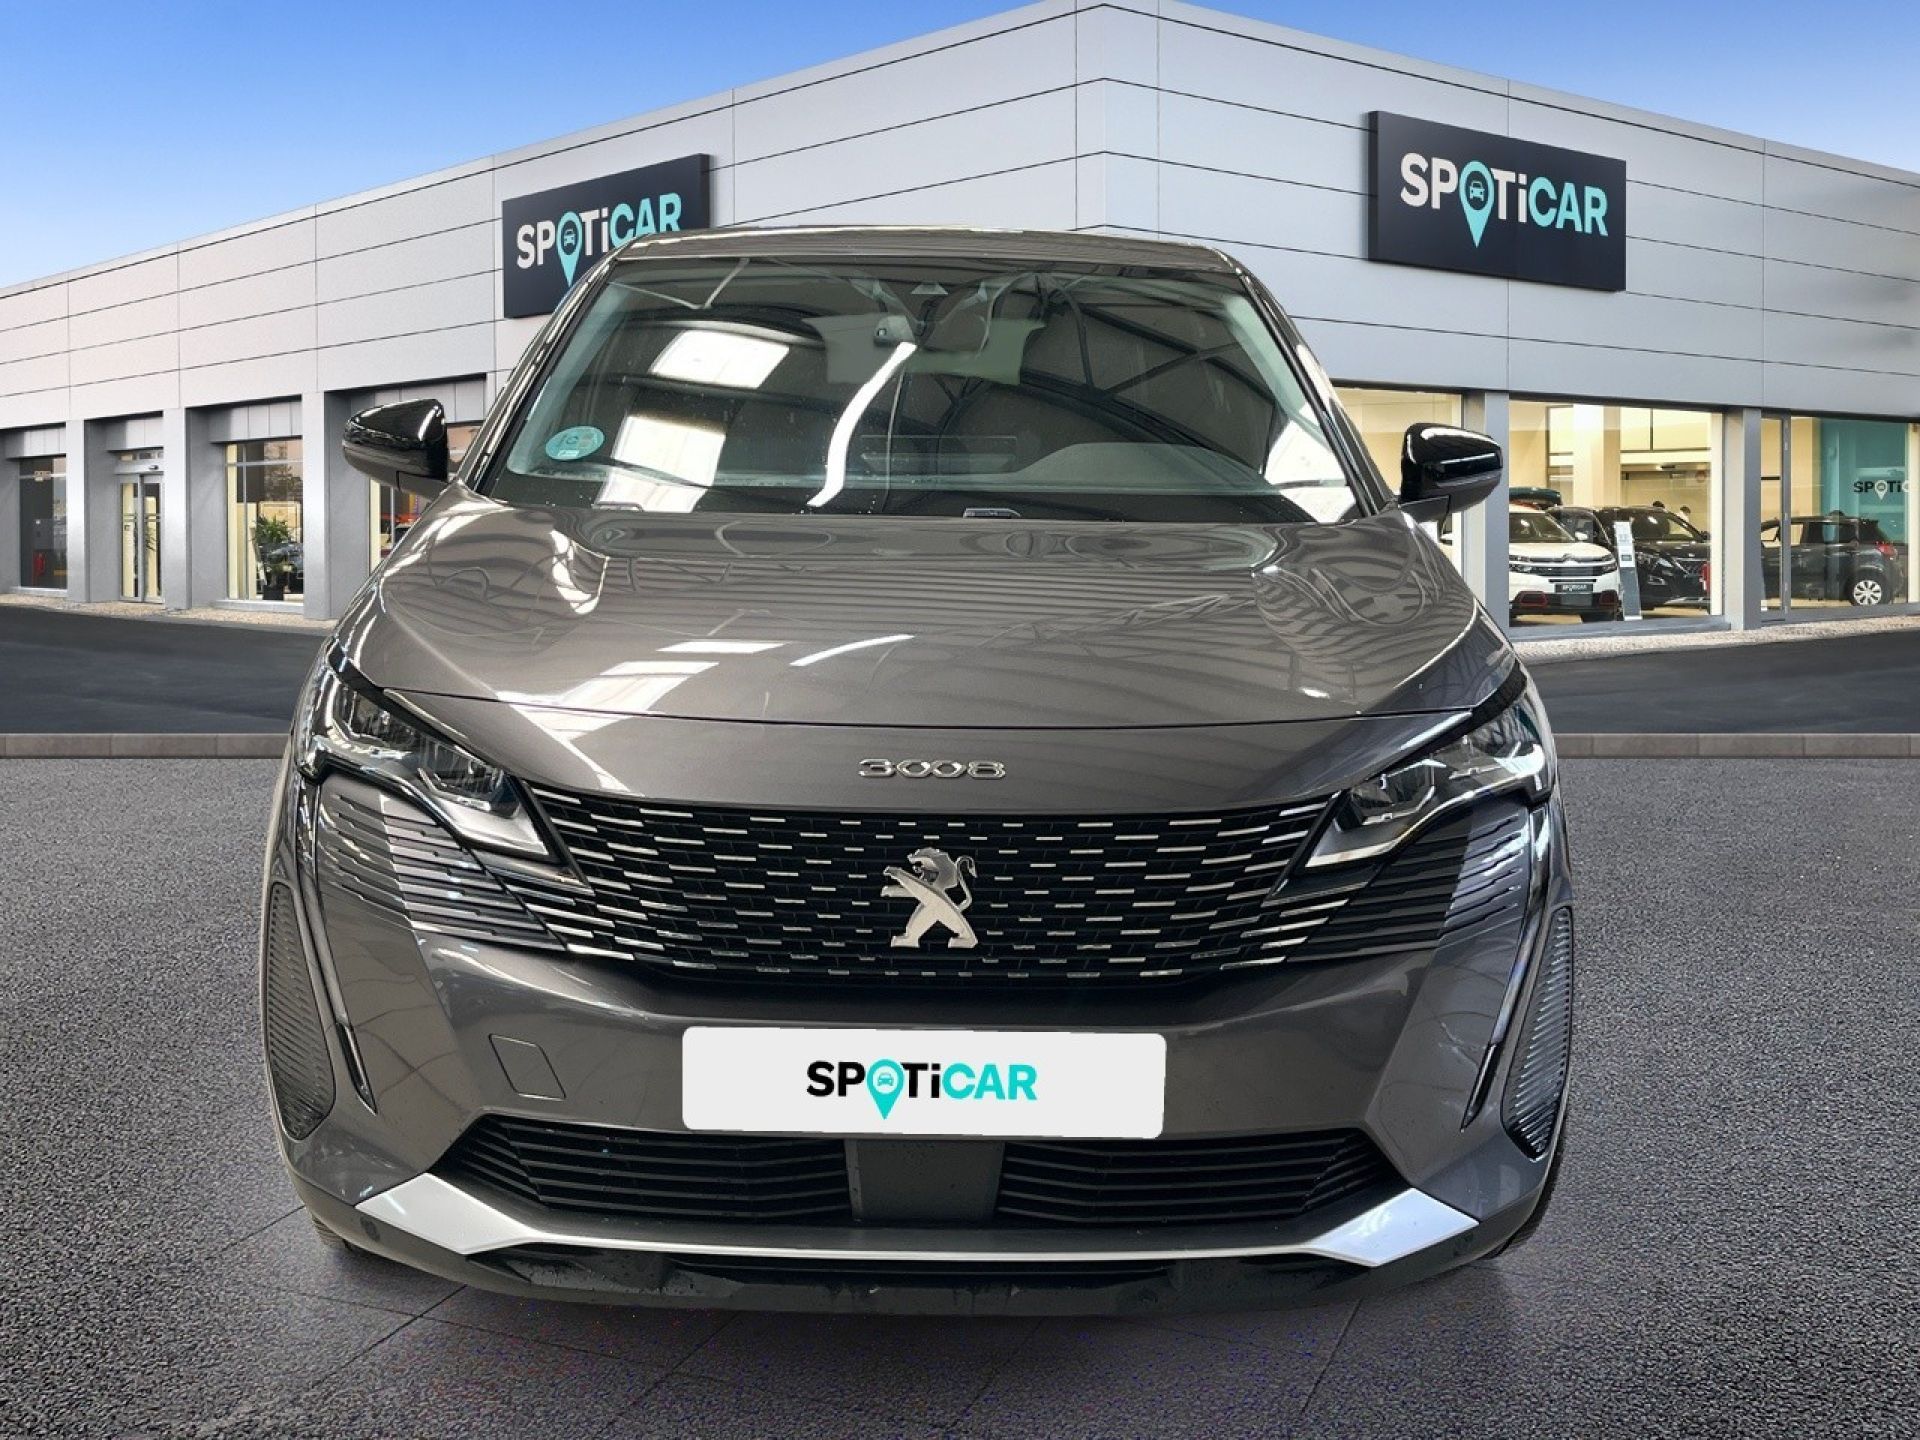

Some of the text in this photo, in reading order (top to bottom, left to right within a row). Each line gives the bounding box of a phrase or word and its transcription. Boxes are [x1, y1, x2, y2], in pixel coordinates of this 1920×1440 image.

[1400, 152, 1609, 248] SPOTiCAR
[858, 758, 1006, 780] 3008
[806, 1058, 1038, 1121] SPOTiCAR
